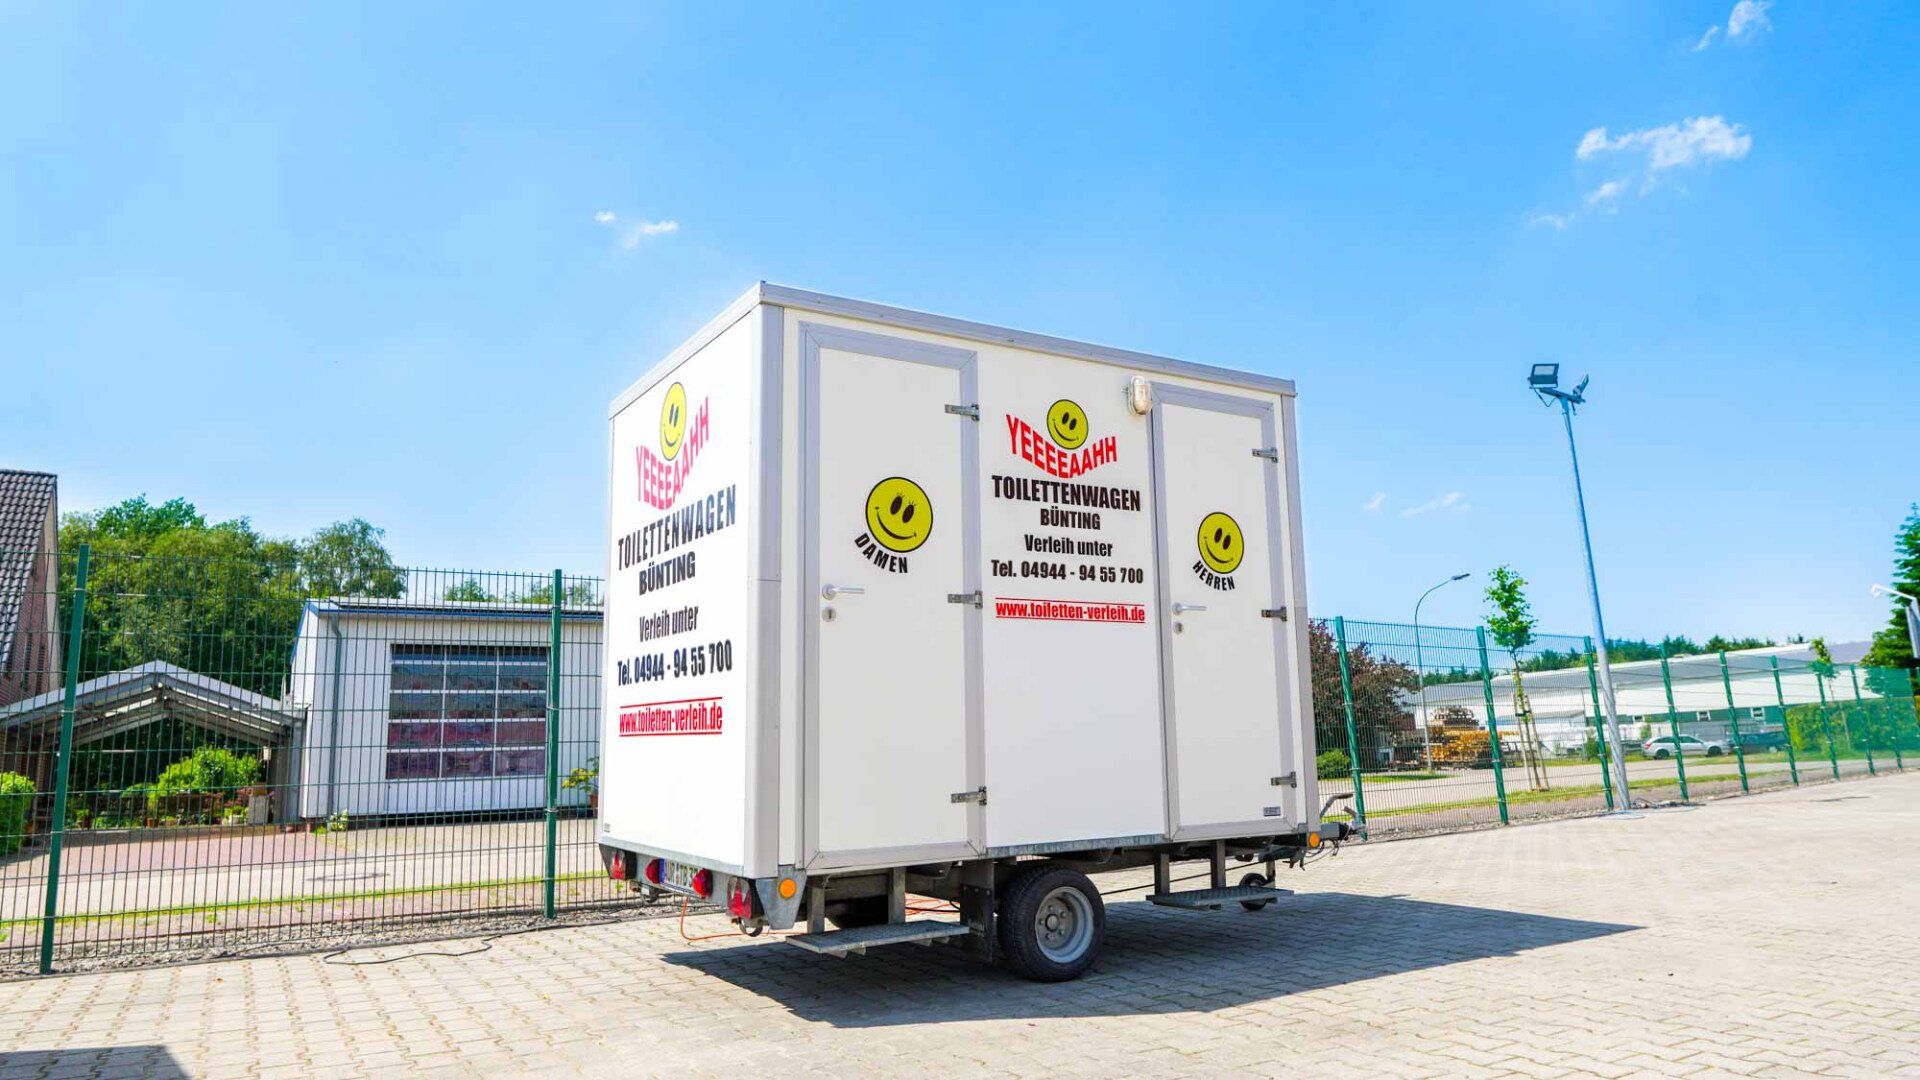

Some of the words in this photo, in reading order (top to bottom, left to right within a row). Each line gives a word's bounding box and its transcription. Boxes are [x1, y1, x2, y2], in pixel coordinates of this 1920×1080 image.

[635, 396, 710, 510] YEEEEAAHH
[1005, 414, 1118, 479] YEEEEAAHH
[991, 475, 1141, 511] TOILETTENWAGEN
[618, 484, 736, 570] TOILETTENWAGEN
[1040, 506, 1101, 530] BÜNTING
[854, 532, 908, 573] DAMEN
[1024, 534, 1075, 555] Verleih
[1077, 541, 1113, 557] unter
[638, 551, 696, 596] BÜNTING
[991, 559, 1017, 578] Tel.
[1021, 561, 1067, 580] 04944
[1079, 565, 1096, 581] 94
[1100, 567, 1116, 583] 55
[1120, 568, 1144, 583] 700
[1192, 561, 1235, 591] HERREN
[639, 609, 670, 642] Verleih
[672, 606, 699, 635] unter
[996, 602, 1145, 622] www.toiletten-verleih.de
[618, 659, 633, 686] Tel.
[634, 653, 665, 683] 04944
[673, 647, 688, 678] 94
[691, 645, 705, 677] 55
[709, 639, 733, 674] 700
[619, 702, 723, 734] www.toiletten-verleih.de
